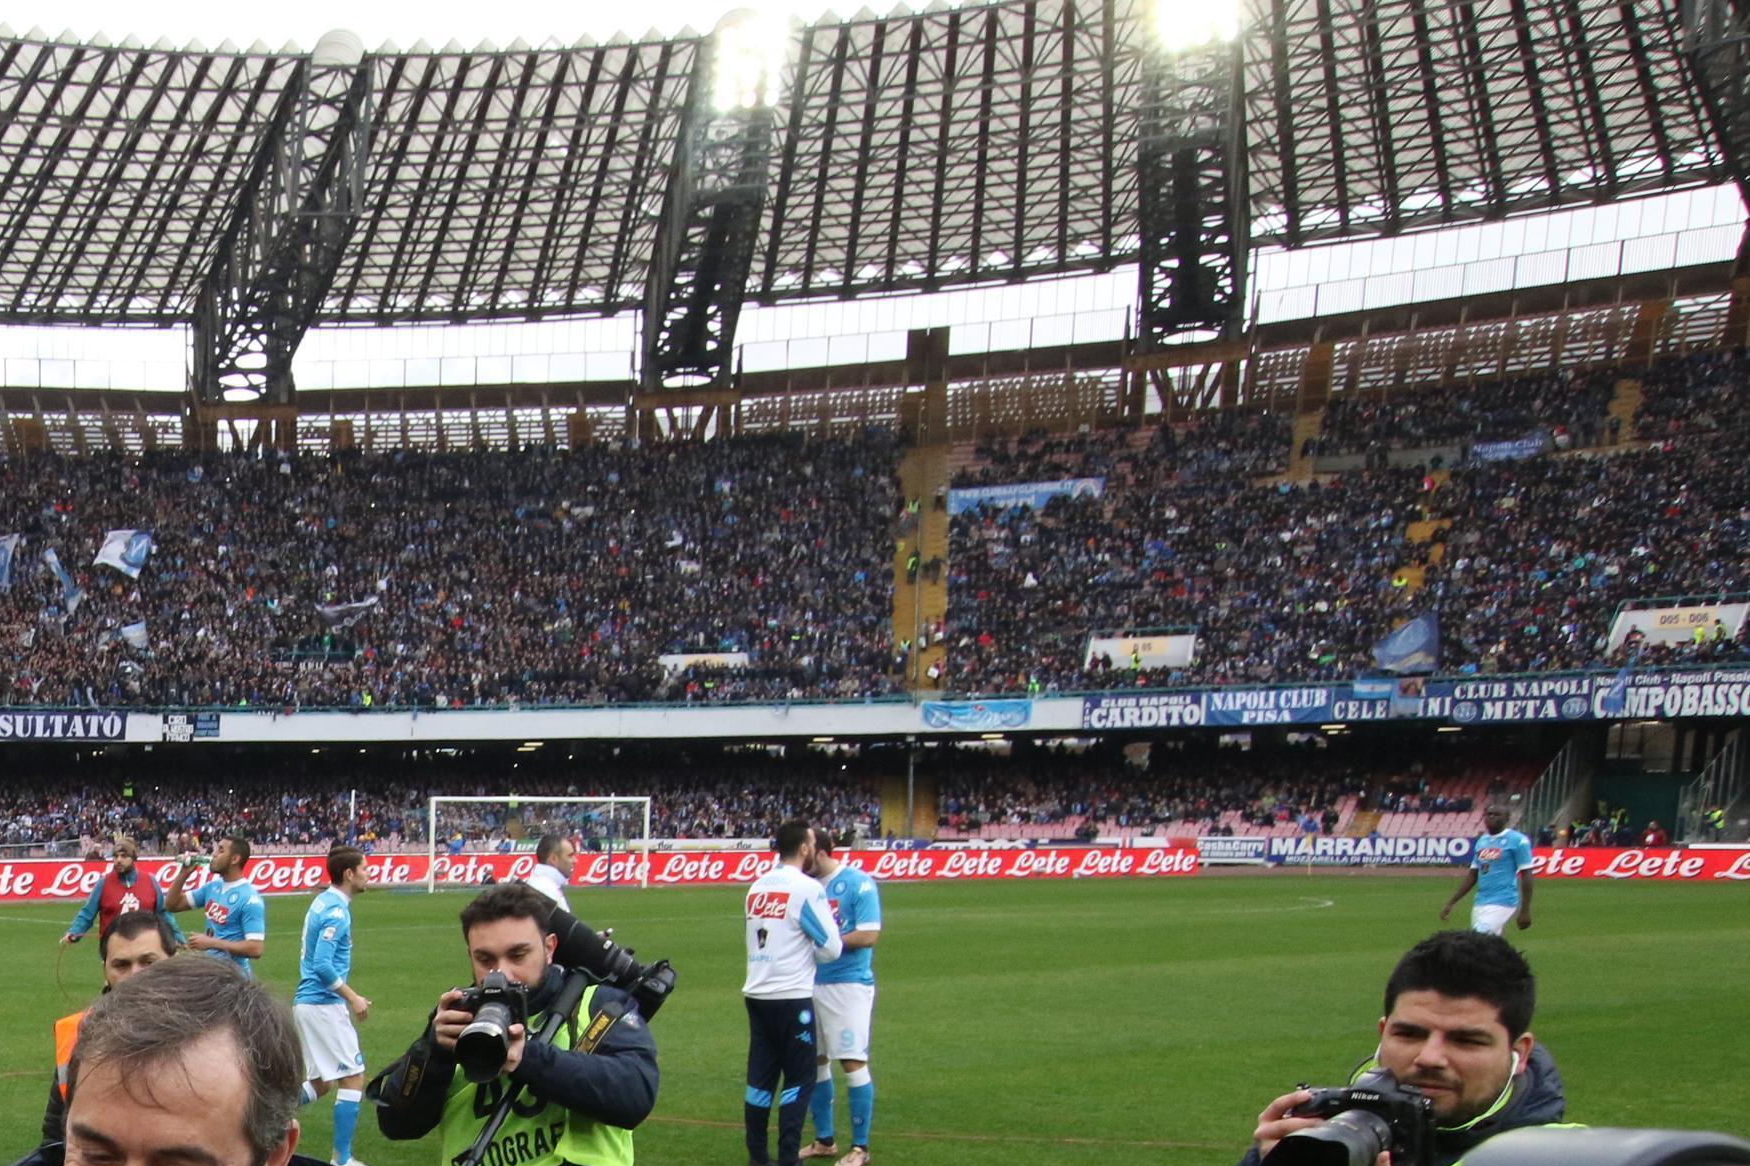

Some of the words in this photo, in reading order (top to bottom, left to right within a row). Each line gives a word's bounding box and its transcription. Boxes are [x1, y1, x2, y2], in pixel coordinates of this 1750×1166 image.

[1454, 682, 1507, 700] CLUB
[1512, 679, 1590, 698] NAPOLI
[1596, 674, 1632, 686] Napli
[1635, 673, 1660, 685] Club
[1670, 672, 1711, 685] Napoli
[1139, 695, 1191, 707] NAPOLI
[1211, 690, 1276, 711] NAPOLI
[1279, 688, 1328, 709] CLUB
[1481, 700, 1558, 720] META
[1594, 684, 1750, 718] CMPOBASS
[1090, 704, 1200, 729] CARDITO
[1241, 709, 1292, 723] PISA
[1136, 848, 1196, 875] Lete
[1271, 838, 1470, 858] MARRANDINO
[1285, 856, 1348, 865] MOZZARELLA
[1350, 856, 1361, 864] DI
[248, 859, 322, 891] Lete
[366, 857, 409, 884] ete
[655, 854, 724, 882] Lete
[728, 853, 780, 881] Let
[870, 851, 932, 878] Lete
[936, 850, 1002, 878] Lete
[1005, 849, 1067, 877] Lete
[1072, 849, 1133, 876] Lete
[1531, 849, 1586, 875] ete
[1594, 849, 1704, 879] Lete
[42, 861, 106, 898] Le
[1351, 1092, 1380, 1100] Nikon
